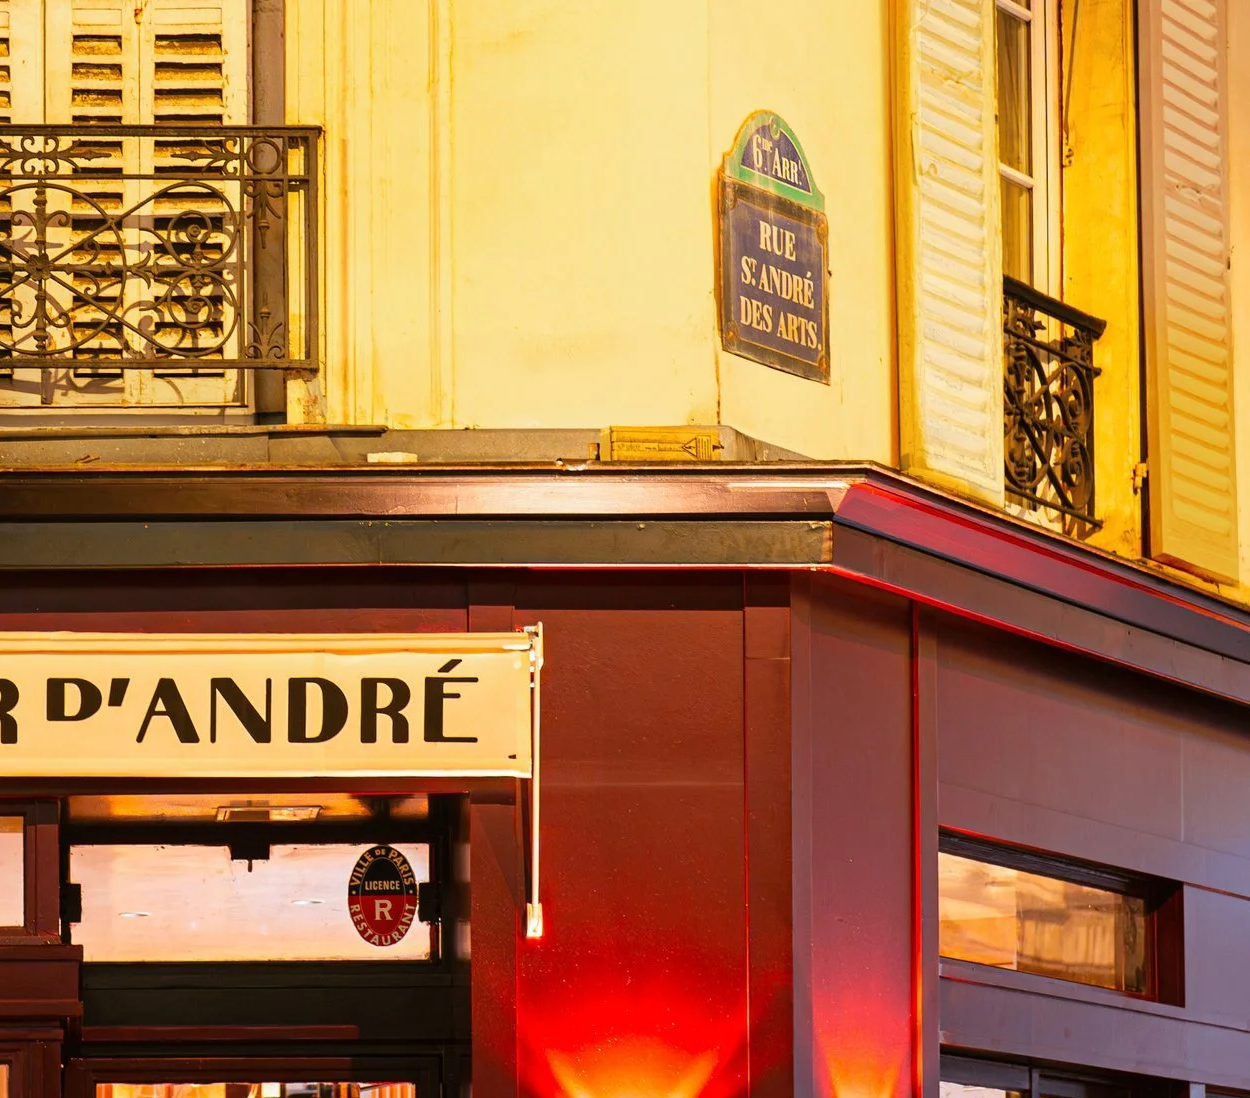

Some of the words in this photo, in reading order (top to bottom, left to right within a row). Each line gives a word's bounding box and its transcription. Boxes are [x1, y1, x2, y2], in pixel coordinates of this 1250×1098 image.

[759, 220, 796, 262] RUE
[759, 267, 815, 310] ANDRÉ
[740, 296, 773, 333] DES
[45, 657, 480, 745] D'ANDRÉ
[350, 852, 374, 887] VILLE
[374, 848, 386, 856] DE
[388, 849, 415, 886] PARIS
[364, 880, 401, 891] LICENCE
[349, 903, 415, 946] RESTAURANT
[374, 899, 393, 921] R
